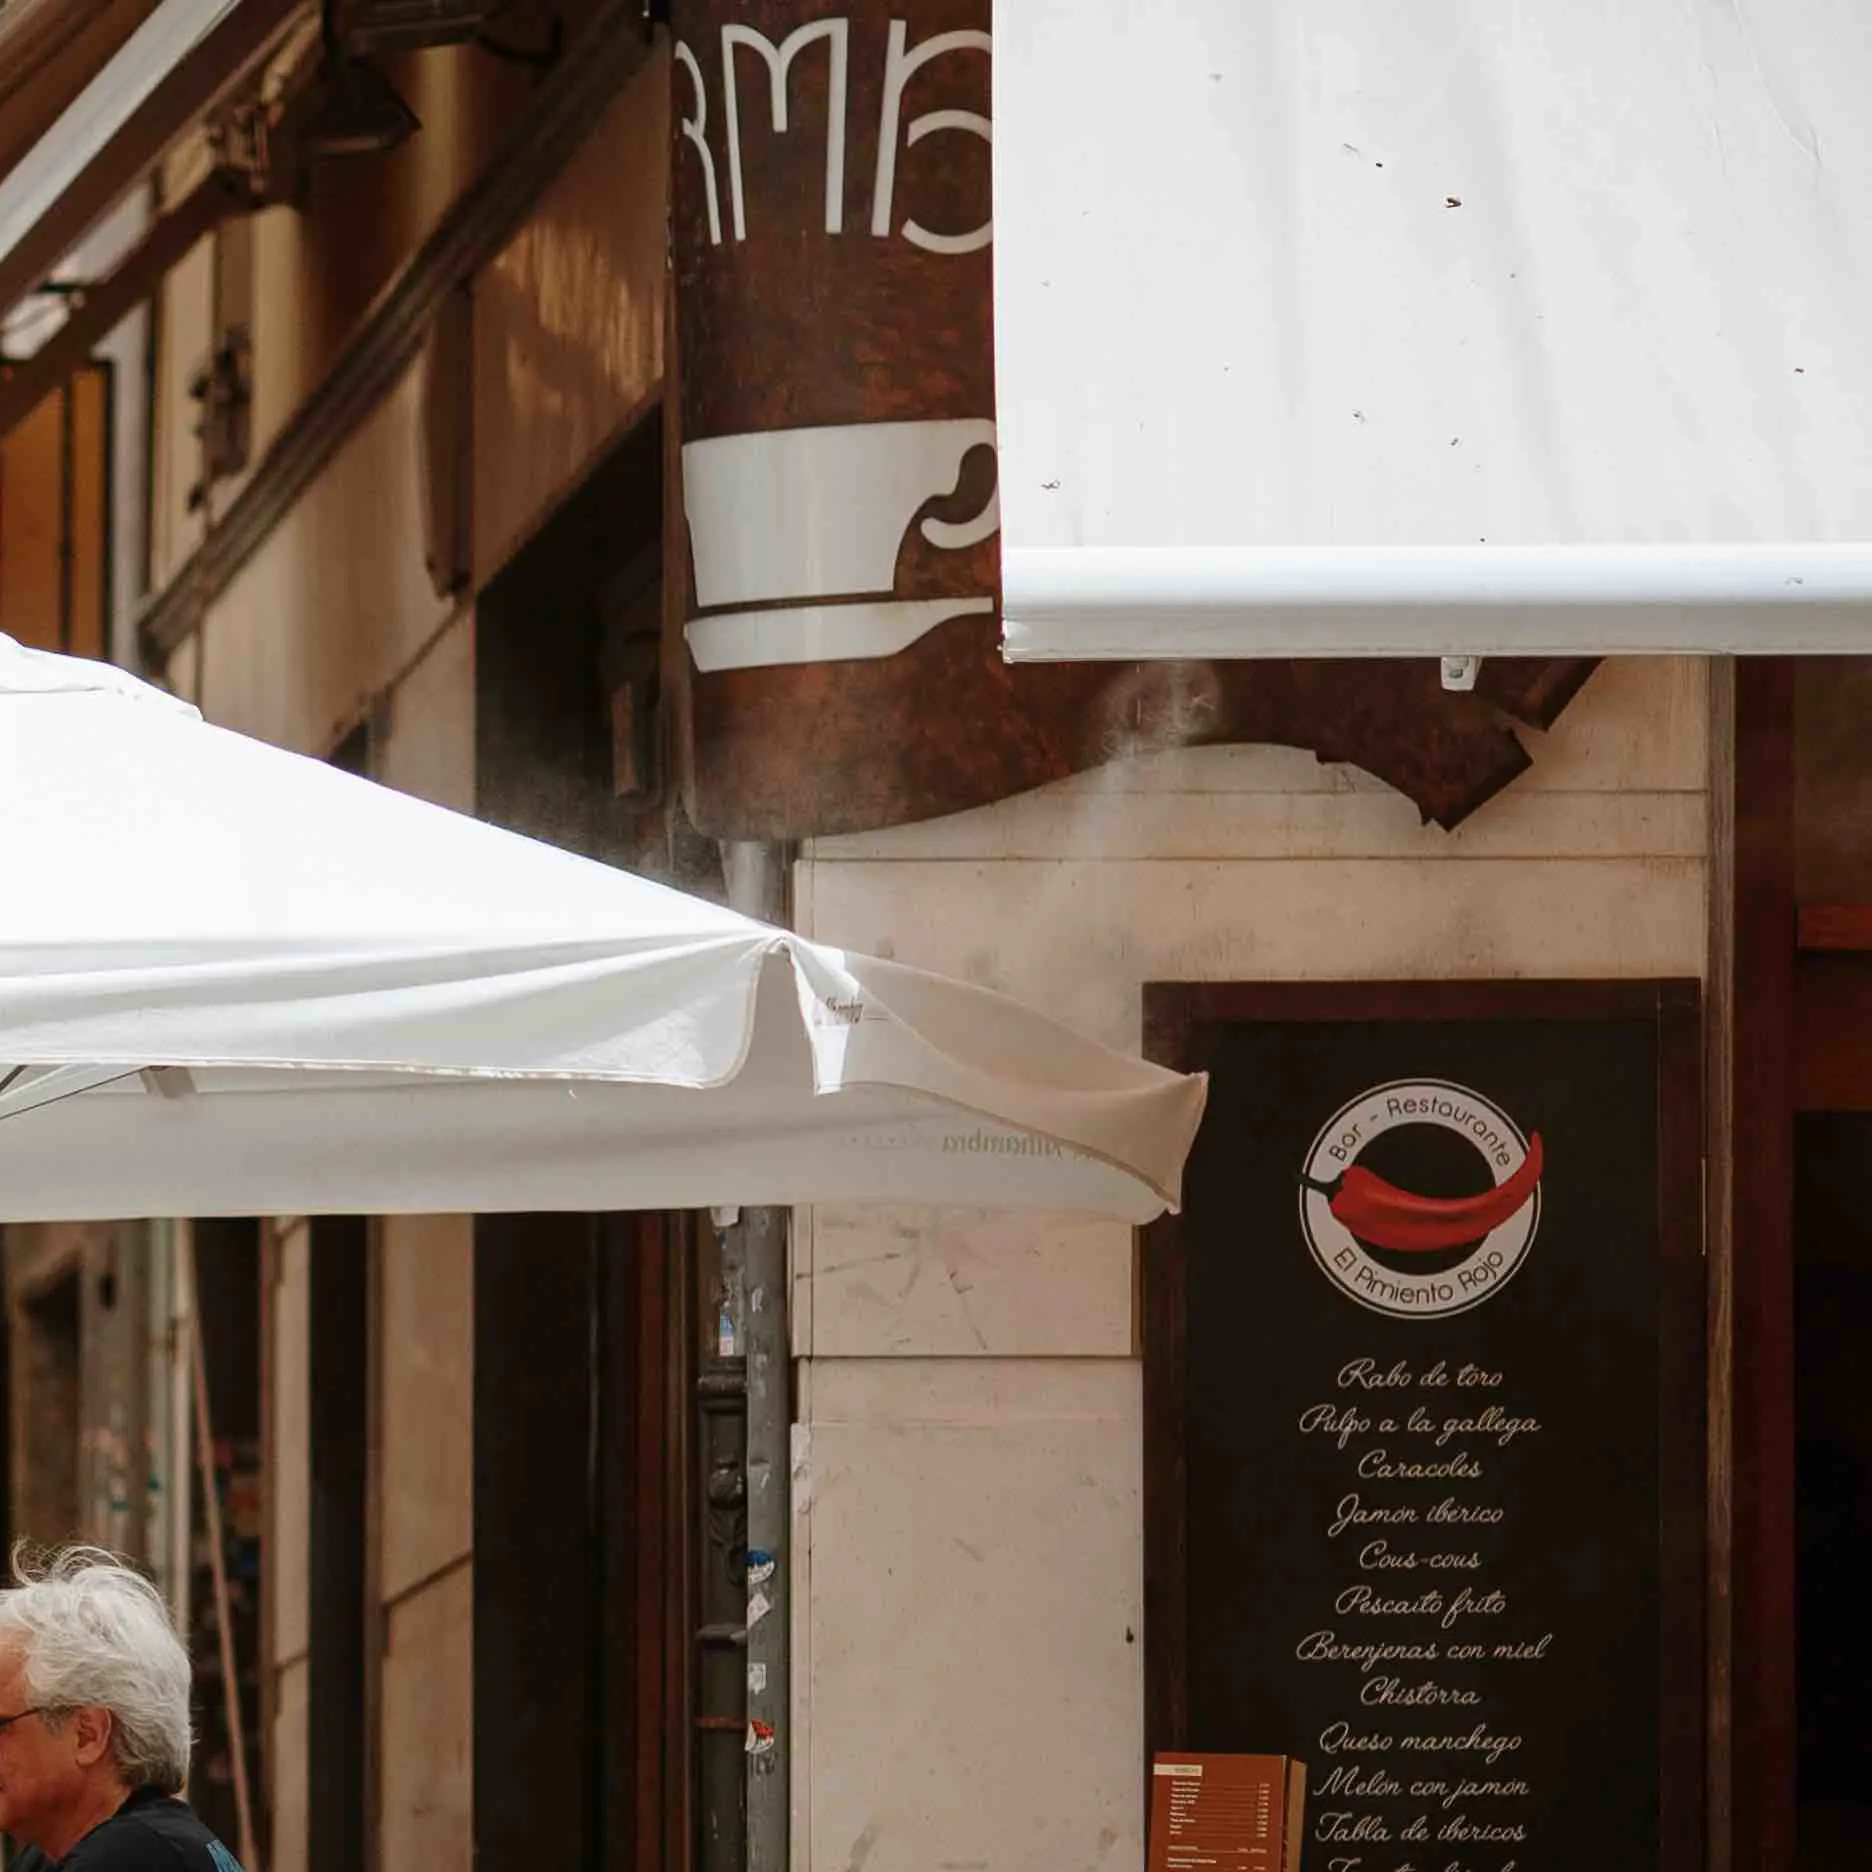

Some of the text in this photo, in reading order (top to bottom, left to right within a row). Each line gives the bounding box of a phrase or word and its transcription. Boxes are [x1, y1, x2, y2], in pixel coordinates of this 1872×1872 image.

[1386, 1096, 1512, 1167] Restaurante
[1332, 1246, 1505, 1305] El Pimiento Rojo
[1337, 1358, 1502, 1389] Rabo de toro
[1299, 1404, 1542, 1449] Pulpo a la gallega
[1358, 1449, 1482, 1478] Caracoles
[1328, 1493, 1419, 1537] Jamón
[1360, 1540, 1481, 1569] Cous-cous
[1440, 1587, 1505, 1629] frito
[1296, 1631, 1552, 1672] Berenjenas con miel
[1360, 1676, 1480, 1705] Chistorra
[1320, 1721, 1522, 1764] Queso manchego
[1312, 1765, 1529, 1809] Melón con jamón
[1315, 1812, 1392, 1841] Tabla
[1400, 1815, 1429, 1841] de
